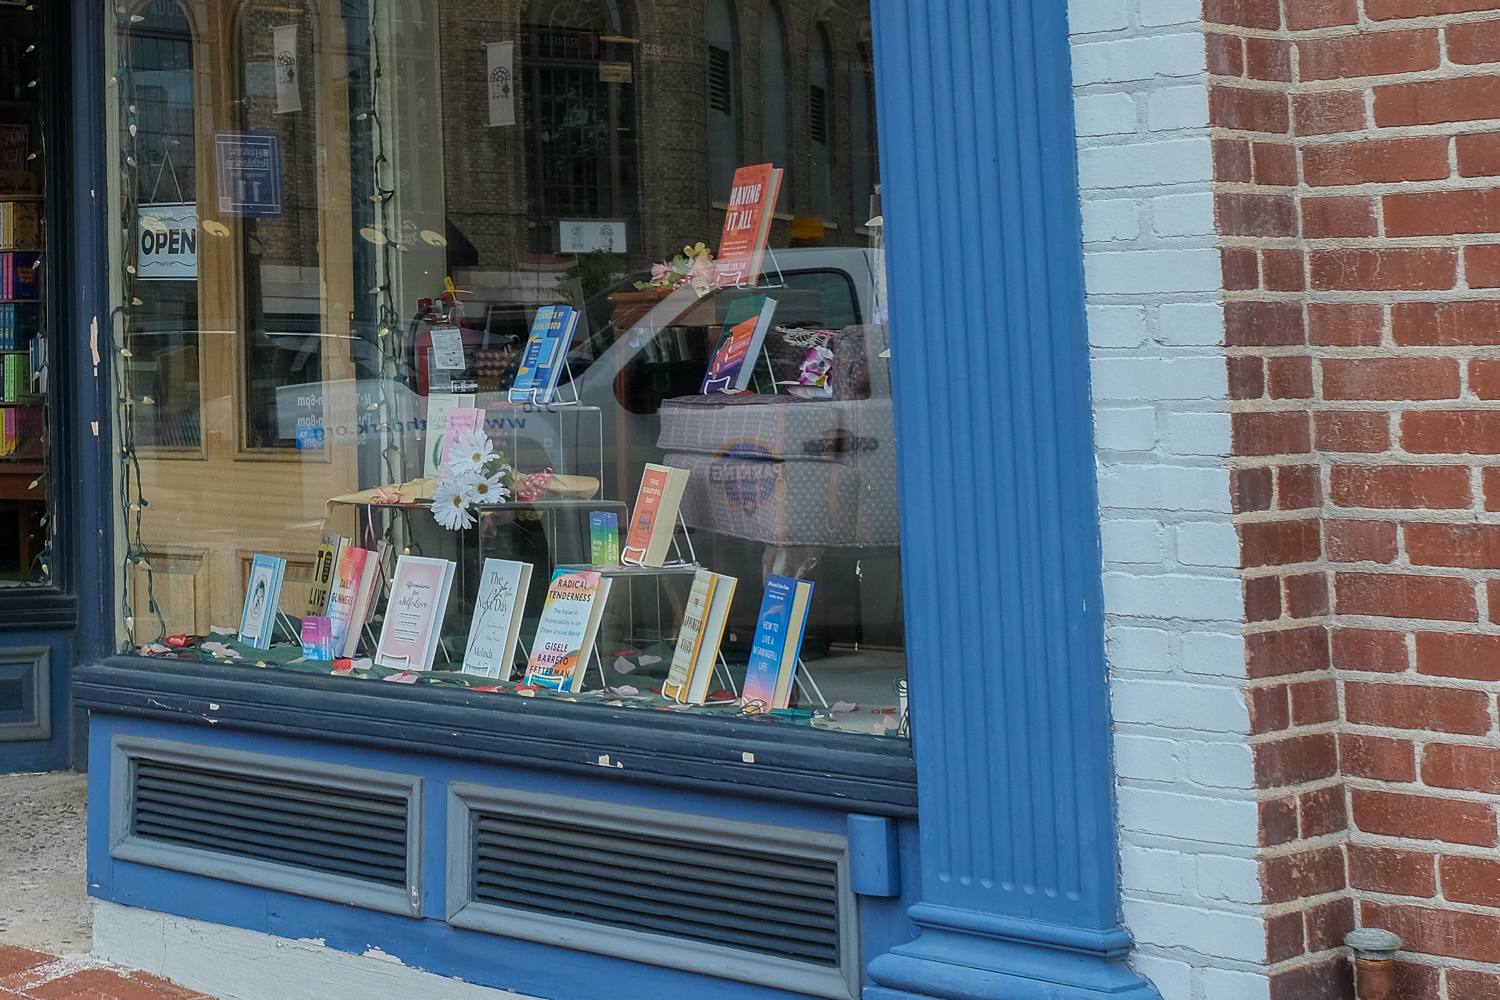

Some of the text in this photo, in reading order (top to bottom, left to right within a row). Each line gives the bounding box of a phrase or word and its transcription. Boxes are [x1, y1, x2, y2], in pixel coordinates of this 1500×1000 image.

[730, 184, 762, 207] HAVING
[727, 210, 753, 231] IT ALL
[141, 228, 196, 256] OPEN
[490, 571, 504, 586] The
[557, 578, 588, 590] RADICAL
[309, 588, 327, 608] LIVE
[549, 590, 591, 602] TENDERNESS
[494, 598, 509, 613] Day
[544, 617, 570, 627] Vulnerability
[763, 620, 779, 633] HOW TO
[540, 626, 553, 635] Often
[762, 634, 770, 645] LIVE
[474, 646, 494, 659] Melinda
[544, 642, 569, 653] GISELE
[753, 645, 778, 661] MEANINGFUL
[537, 654, 569, 666] BARRETO
[758, 661, 768, 672] LIFE
[529, 665, 570, 679] FETTERMAN
